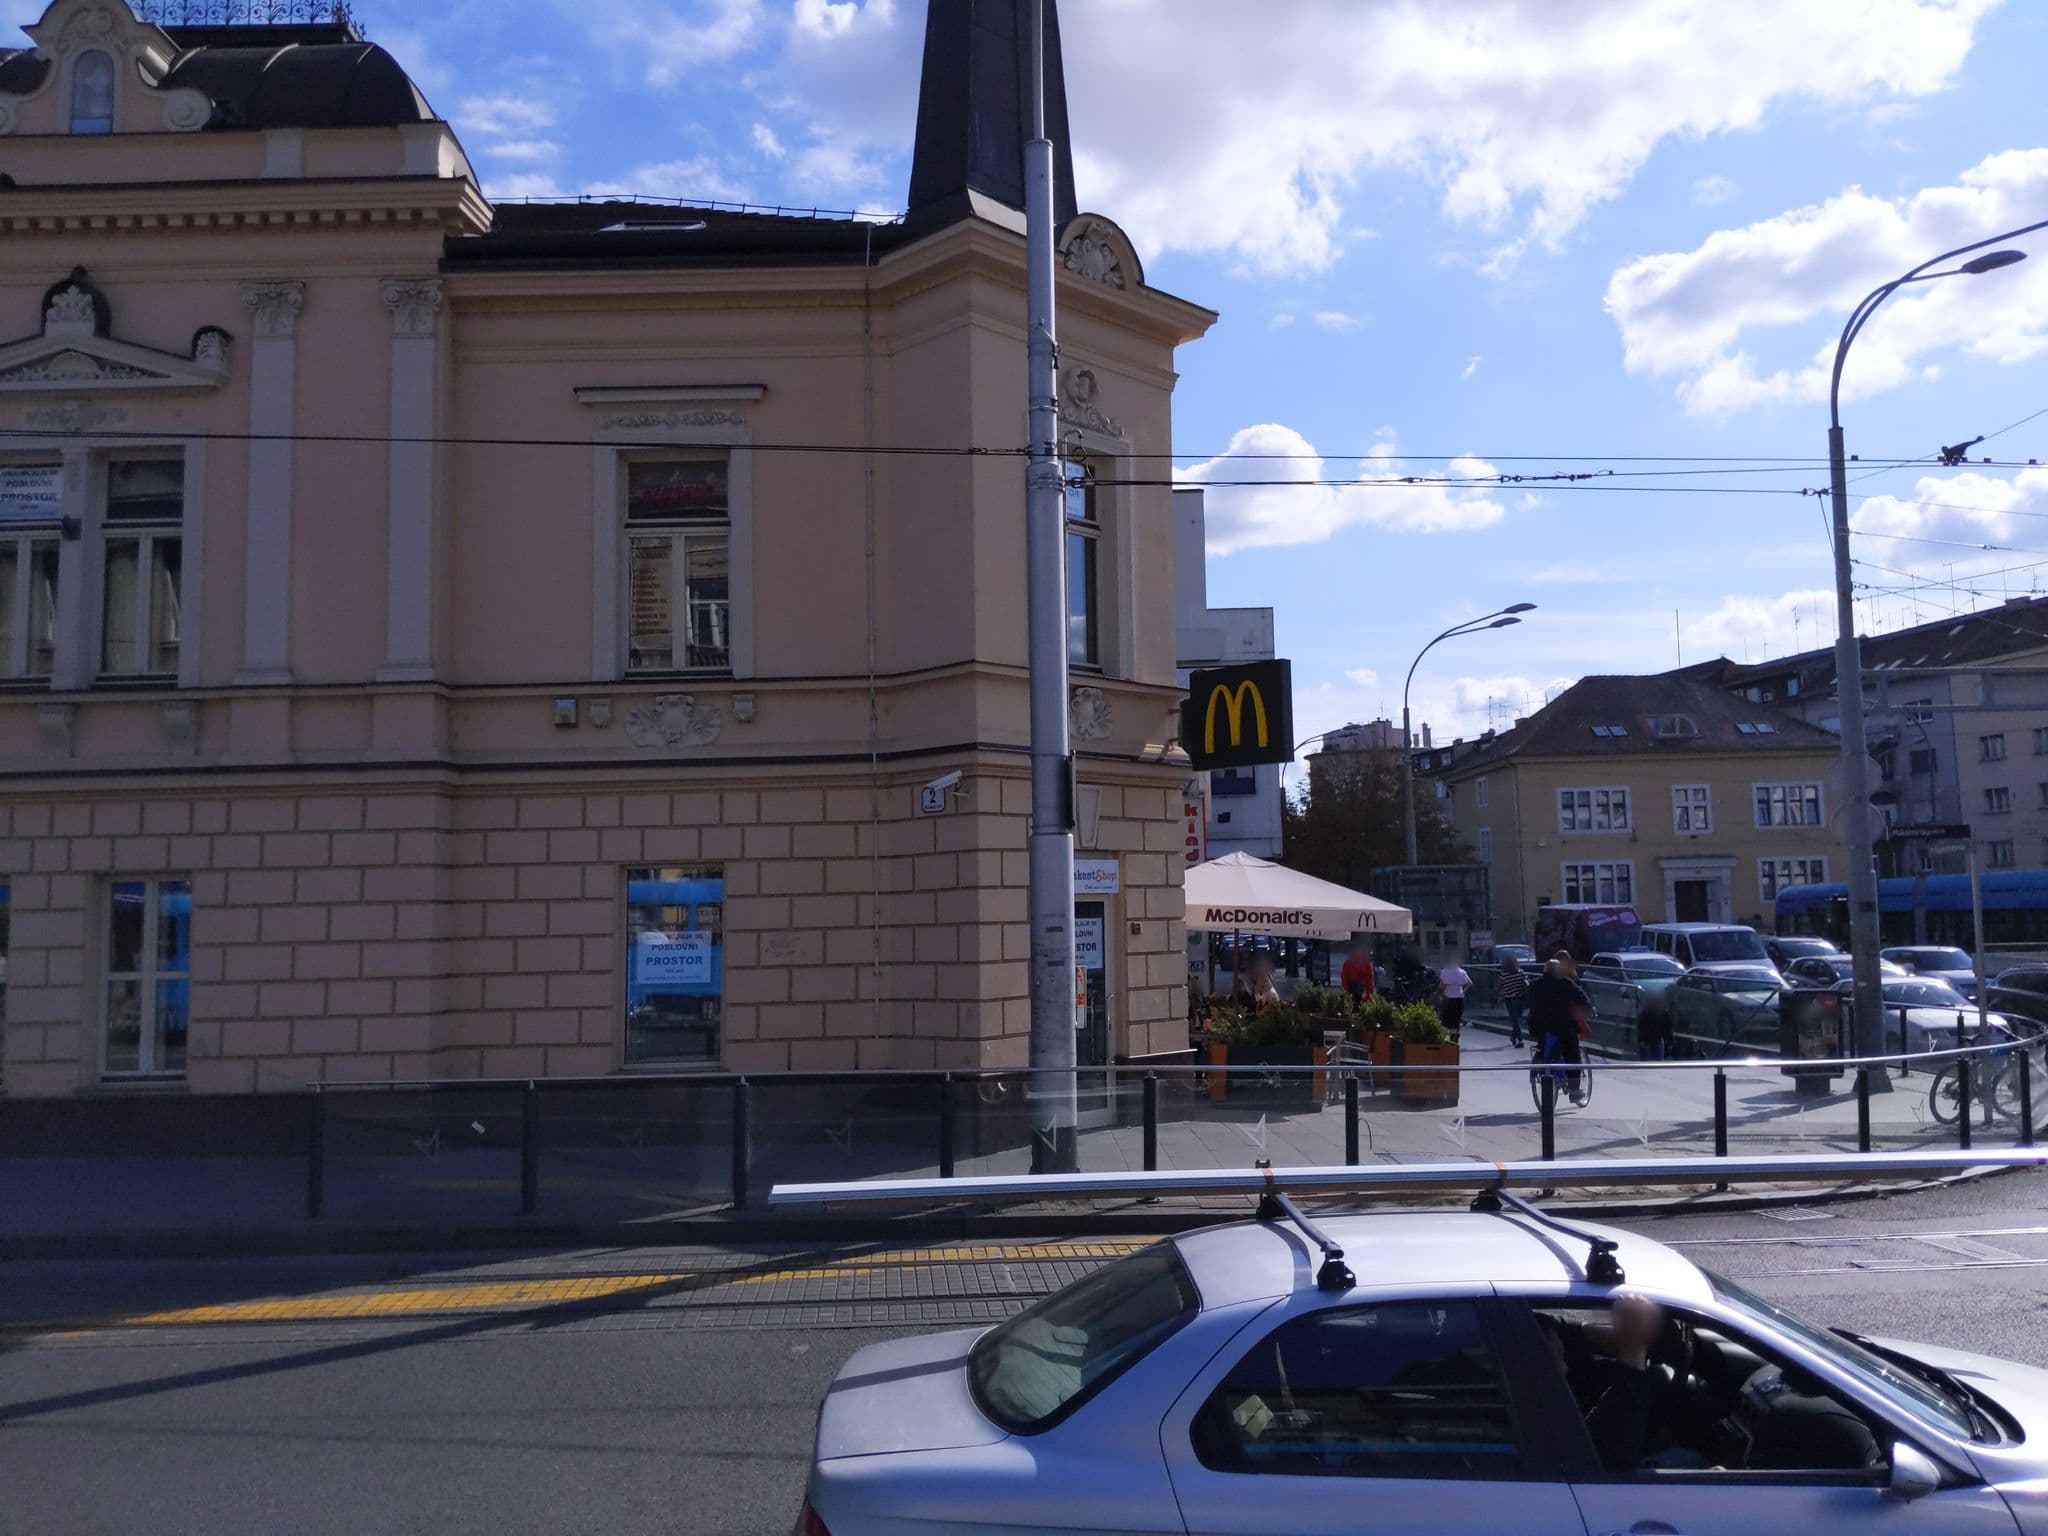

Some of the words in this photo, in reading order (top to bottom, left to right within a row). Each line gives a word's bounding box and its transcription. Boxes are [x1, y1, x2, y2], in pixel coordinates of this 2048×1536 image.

[1074, 868, 1117, 883] kontShop
[1205, 908, 1313, 925] McDonald's
[1075, 930, 1094, 938] LOVNI
[651, 943, 699, 951] POSLOVNI
[1076, 942, 1097, 952] STOR
[646, 956, 703, 966] PROSTOR
